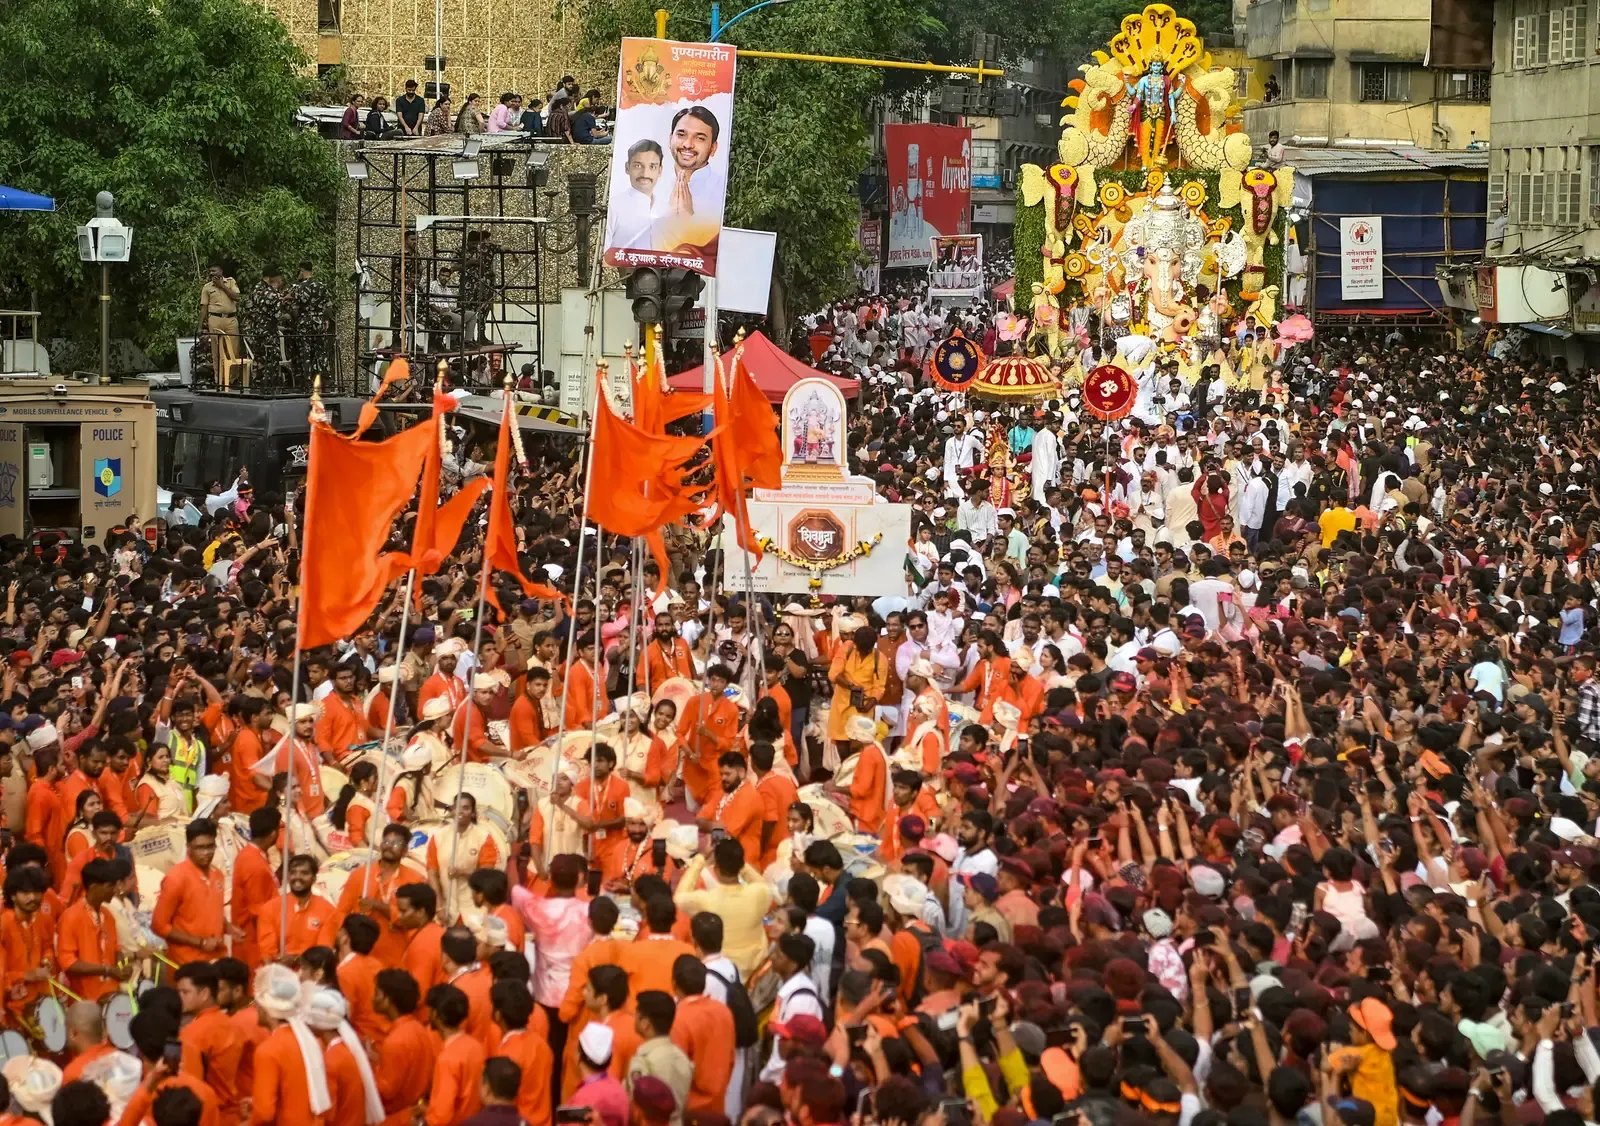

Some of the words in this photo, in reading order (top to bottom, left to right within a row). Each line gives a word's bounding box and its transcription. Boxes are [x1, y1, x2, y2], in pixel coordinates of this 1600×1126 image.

[671, 47, 730, 61] पुण्यनगरीत
[682, 257, 704, 269] काळे
[12, 408, 37, 416] MOBILE
[37, 408, 83, 416] SURVEILLANCE
[84, 408, 109, 416] VEHICLE
[0, 429, 17, 442] OLICE
[92, 428, 124, 441] POLICE
[797, 525, 836, 552] शिवमुद्रा
